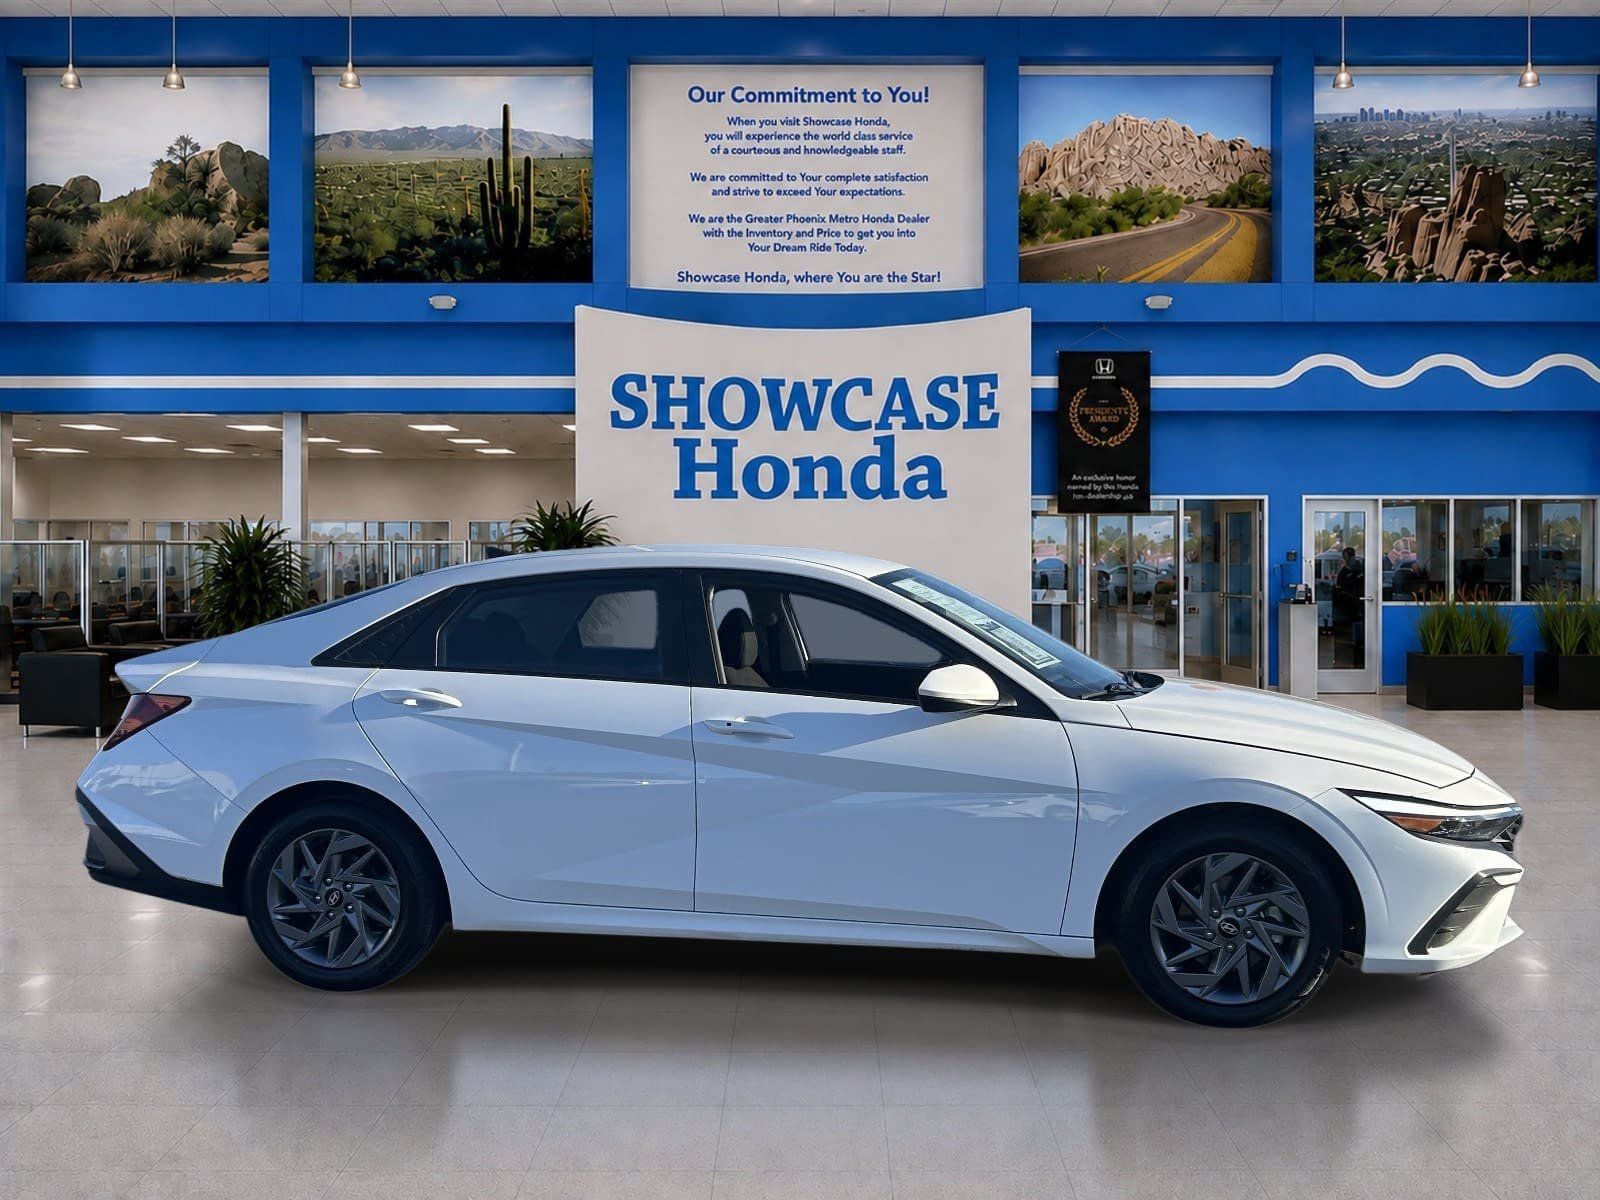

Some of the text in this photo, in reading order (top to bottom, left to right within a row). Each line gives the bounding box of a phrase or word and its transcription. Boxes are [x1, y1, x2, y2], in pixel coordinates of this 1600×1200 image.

[688, 86, 929, 103] Our Commitment to You!
[726, 116, 890, 129] When you visit Showcase Honda,
[704, 130, 913, 143] you will experience the world class service
[710, 144, 721, 155] of
[723, 147, 729, 155] a
[731, 146, 781, 155] courteous
[783, 145, 801, 155] and
[881, 144, 906, 155] staff.
[690, 172, 707, 182] We
[728, 172, 783, 182] committed
[786, 173, 797, 182] to
[799, 172, 822, 182] Your
[825, 172, 871, 185] complete
[874, 172, 929, 182] satisfaction
[711, 186, 905, 200] and strive to exceed Your expectations.
[688, 213, 930, 224] We are the Greater Phoenix Metro Honda Dealer
[702, 227, 916, 240] with the Inventory and Price to get you into
[748, 242, 867, 255] Your Dream Ride Today.
[677, 270, 941, 285] Showcase Honda, where You are the Star!
[609, 373, 1001, 431] SHOWCASE
[672, 433, 948, 501] Honda
[1071, 473, 1137, 482] An exclusive honor
[1093, 482, 1102, 492] by
